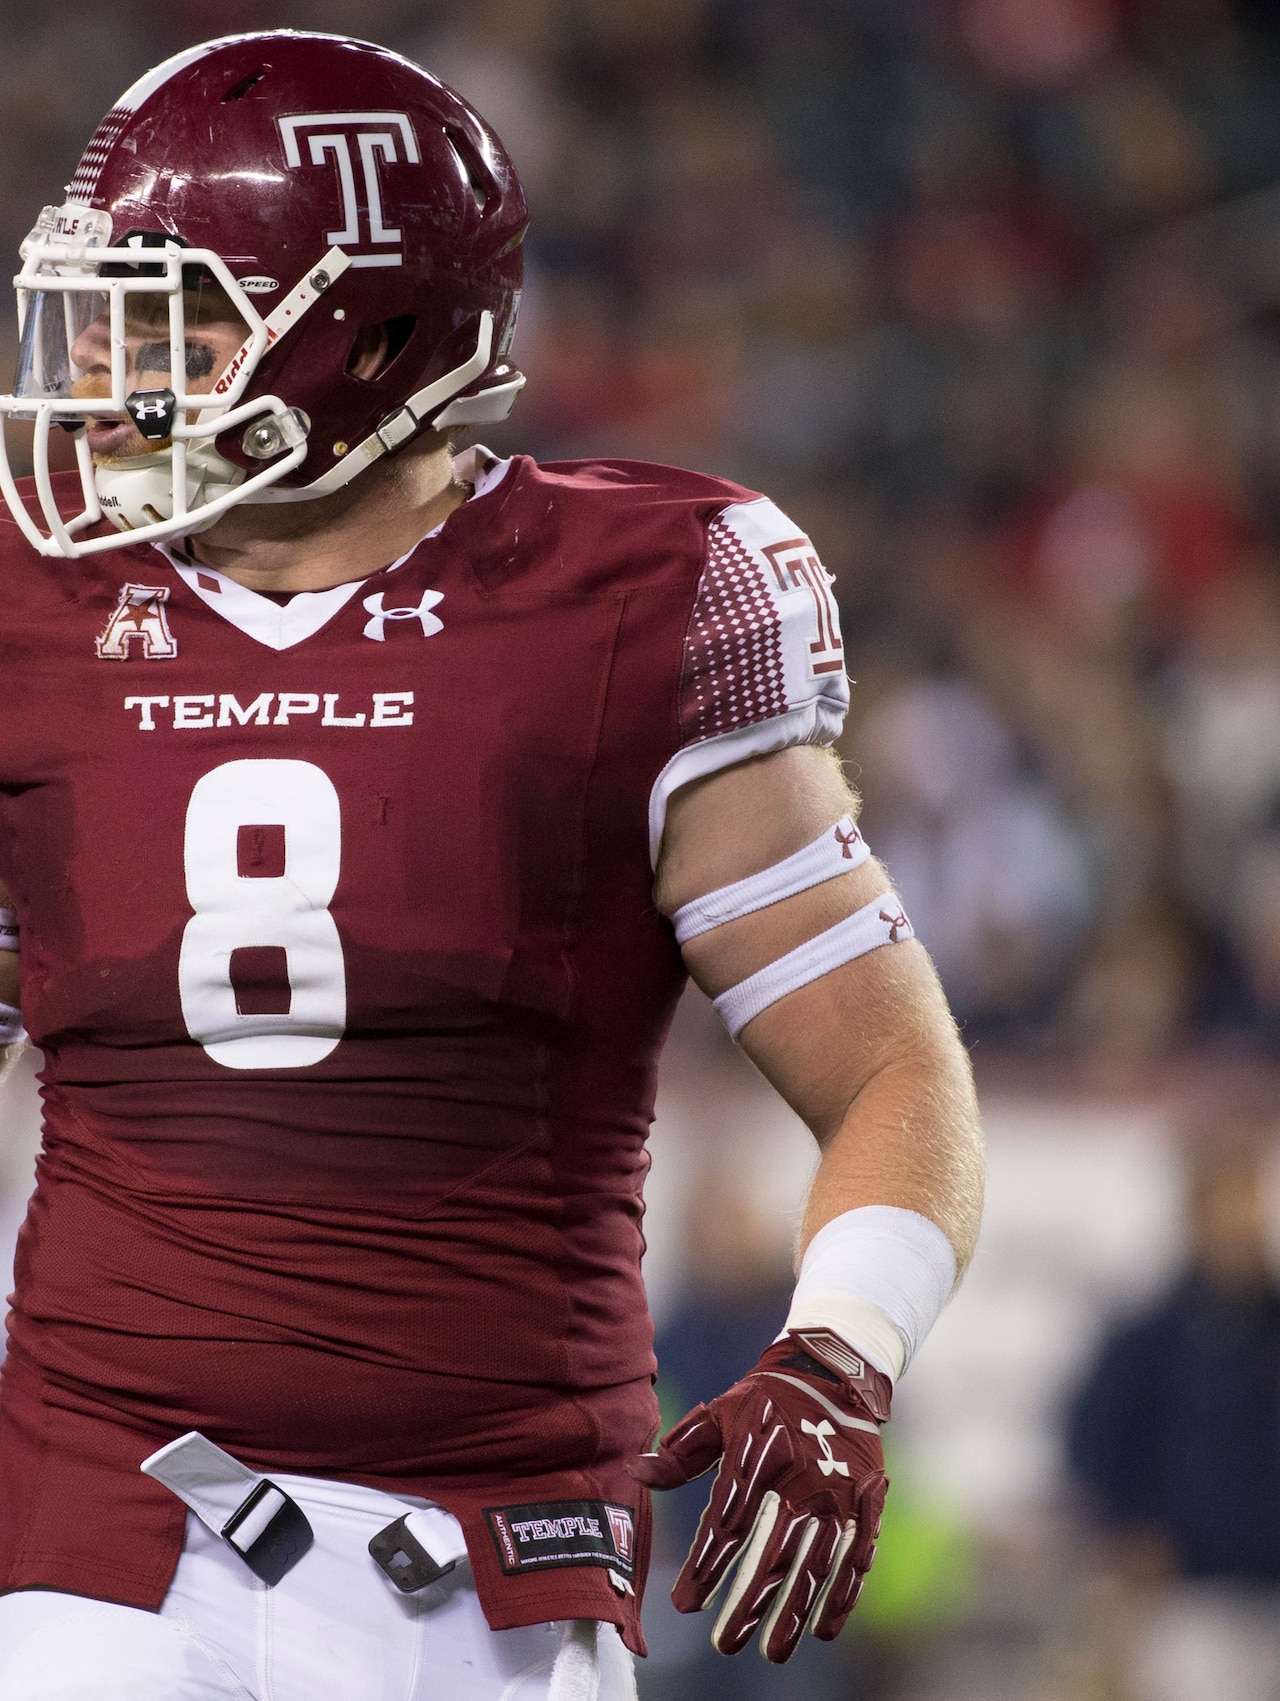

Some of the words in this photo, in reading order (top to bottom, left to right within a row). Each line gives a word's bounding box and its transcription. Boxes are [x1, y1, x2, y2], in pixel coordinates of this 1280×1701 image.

[276, 111, 421, 268] T
[239, 280, 278, 289] SPEED
[123, 690, 415, 731] TEMPLE
[177, 758, 347, 1070] 8
[494, 1514, 516, 1566] AUTHENTIC
[511, 1516, 604, 1543] TEMPLE
